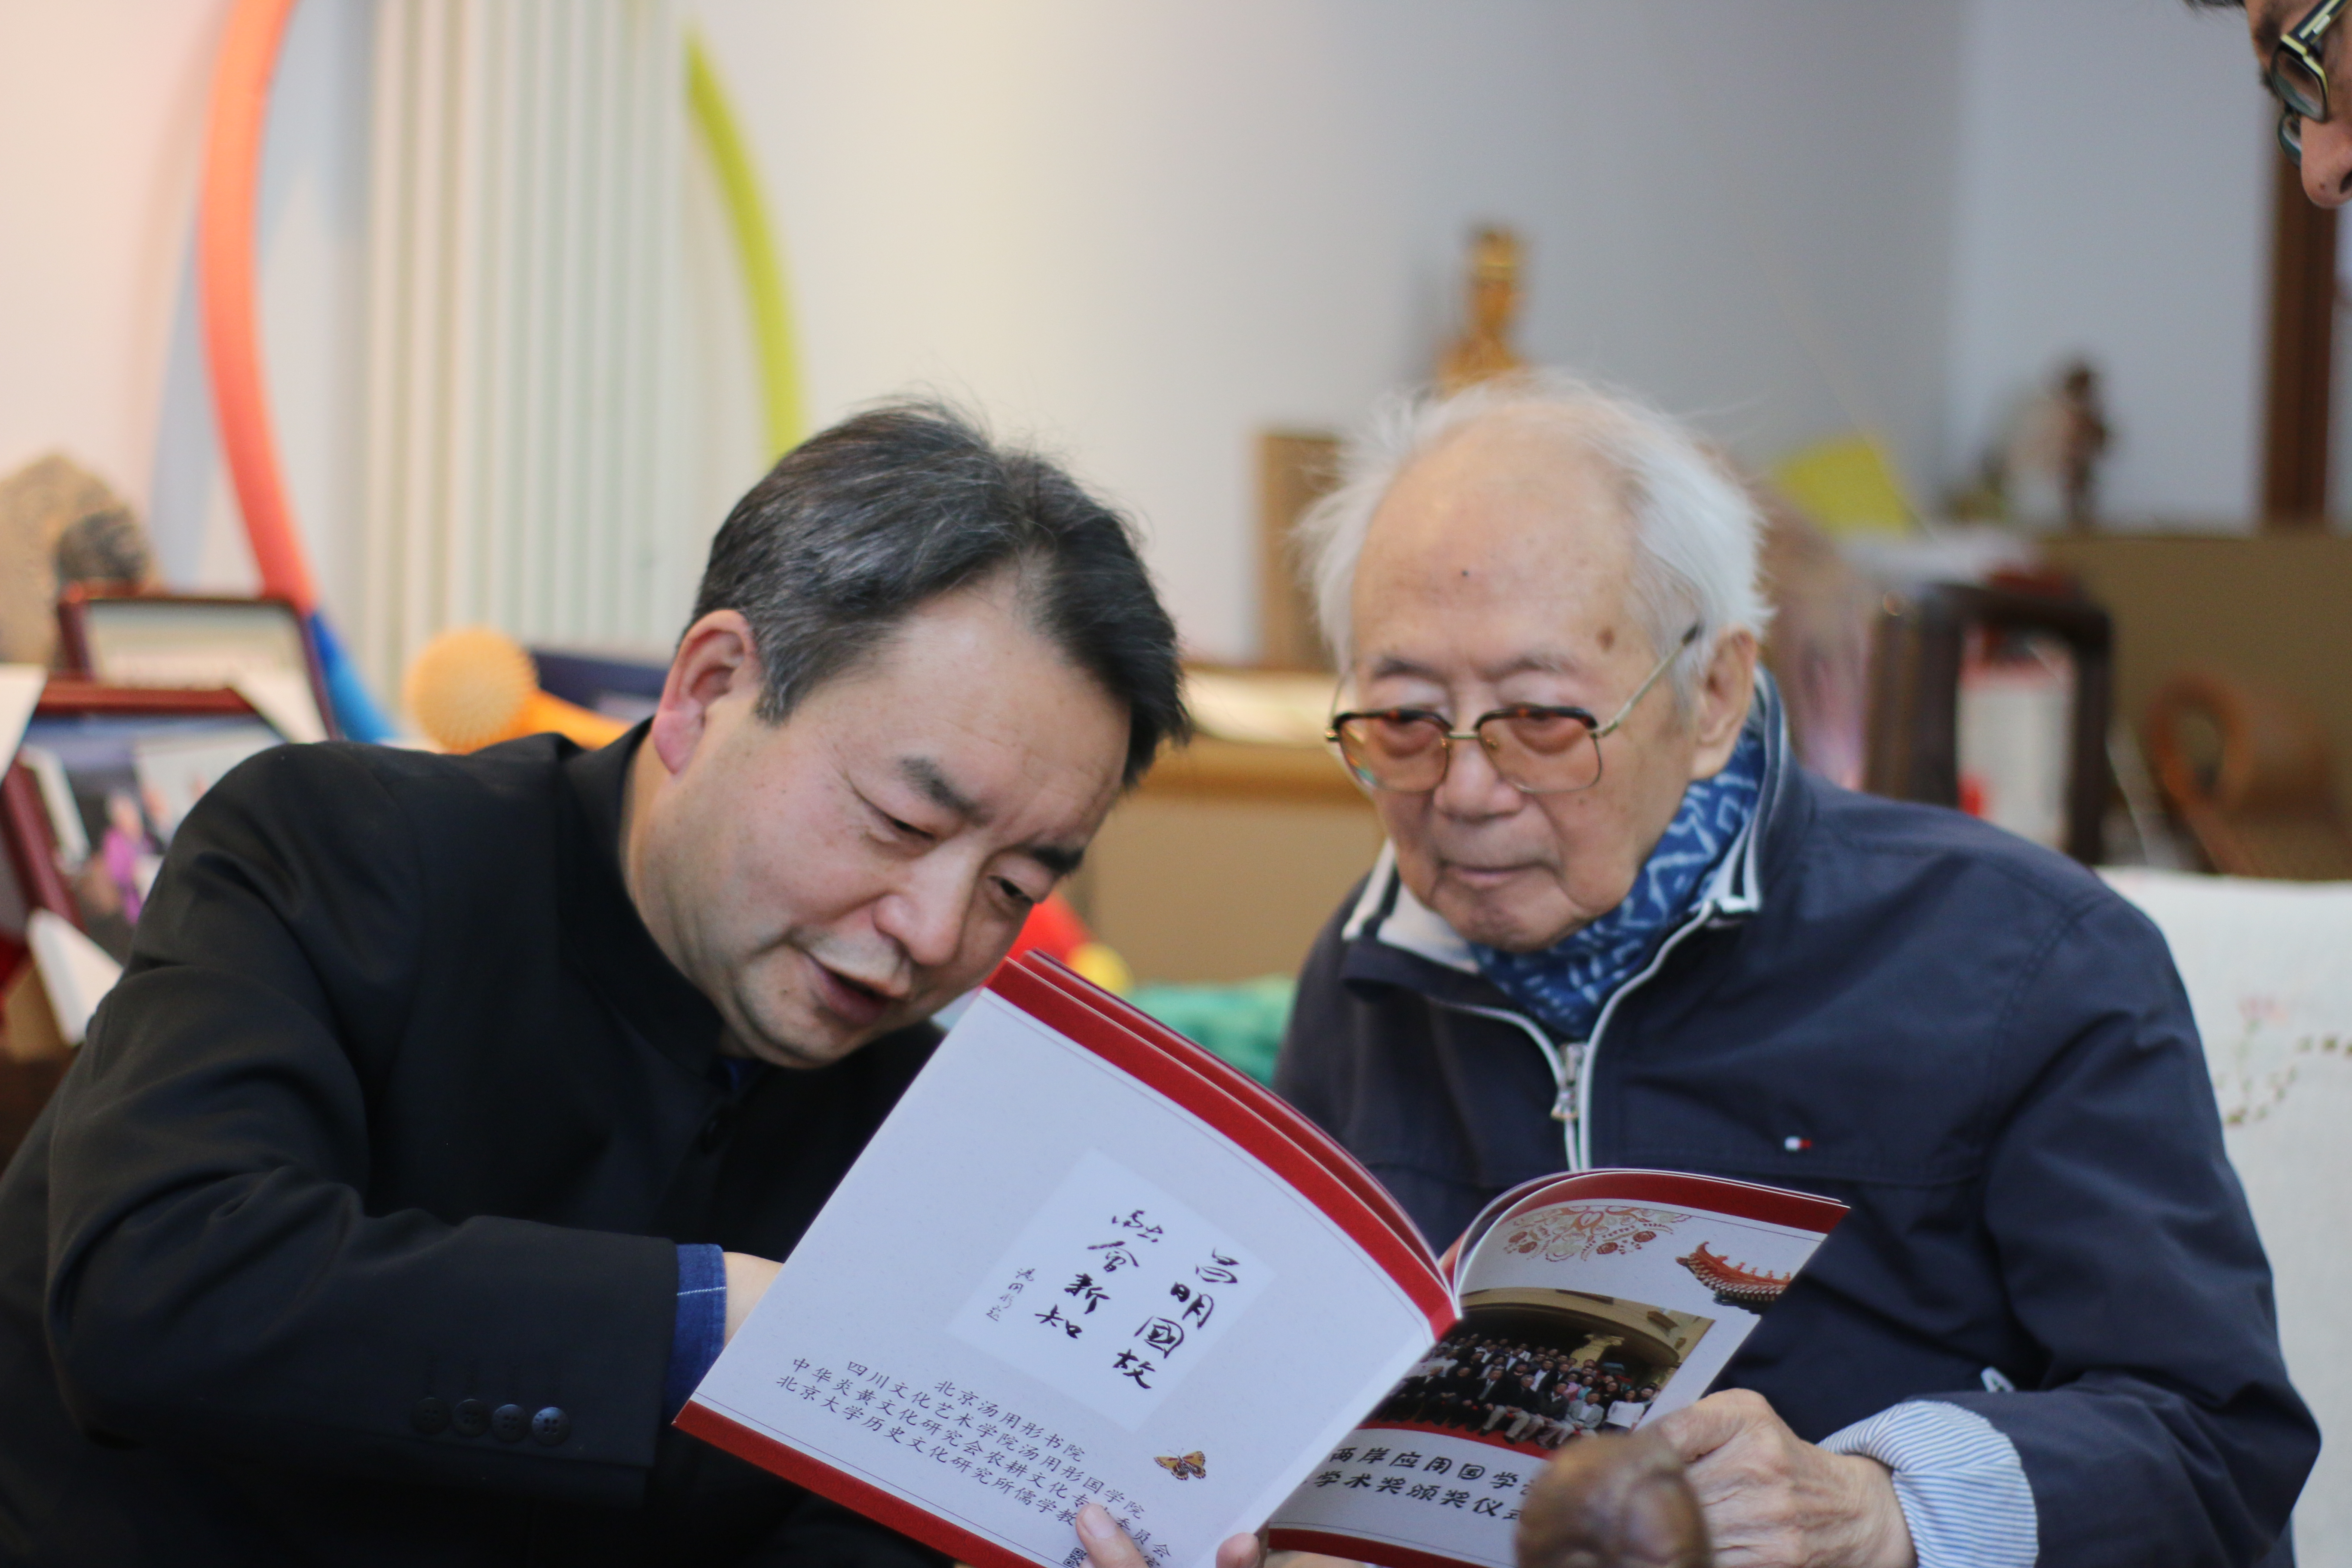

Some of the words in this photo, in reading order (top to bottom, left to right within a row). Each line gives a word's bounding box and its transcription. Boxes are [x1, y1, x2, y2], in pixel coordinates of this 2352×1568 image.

[793, 1358, 1172, 1558] 中华炎黄文化研究会农耕文化专委员会
[847, 1361, 1145, 1519] 四川文化艺术学院汤用彤国学院
[934, 1381, 1085, 1462] 北京汤用彤书院
